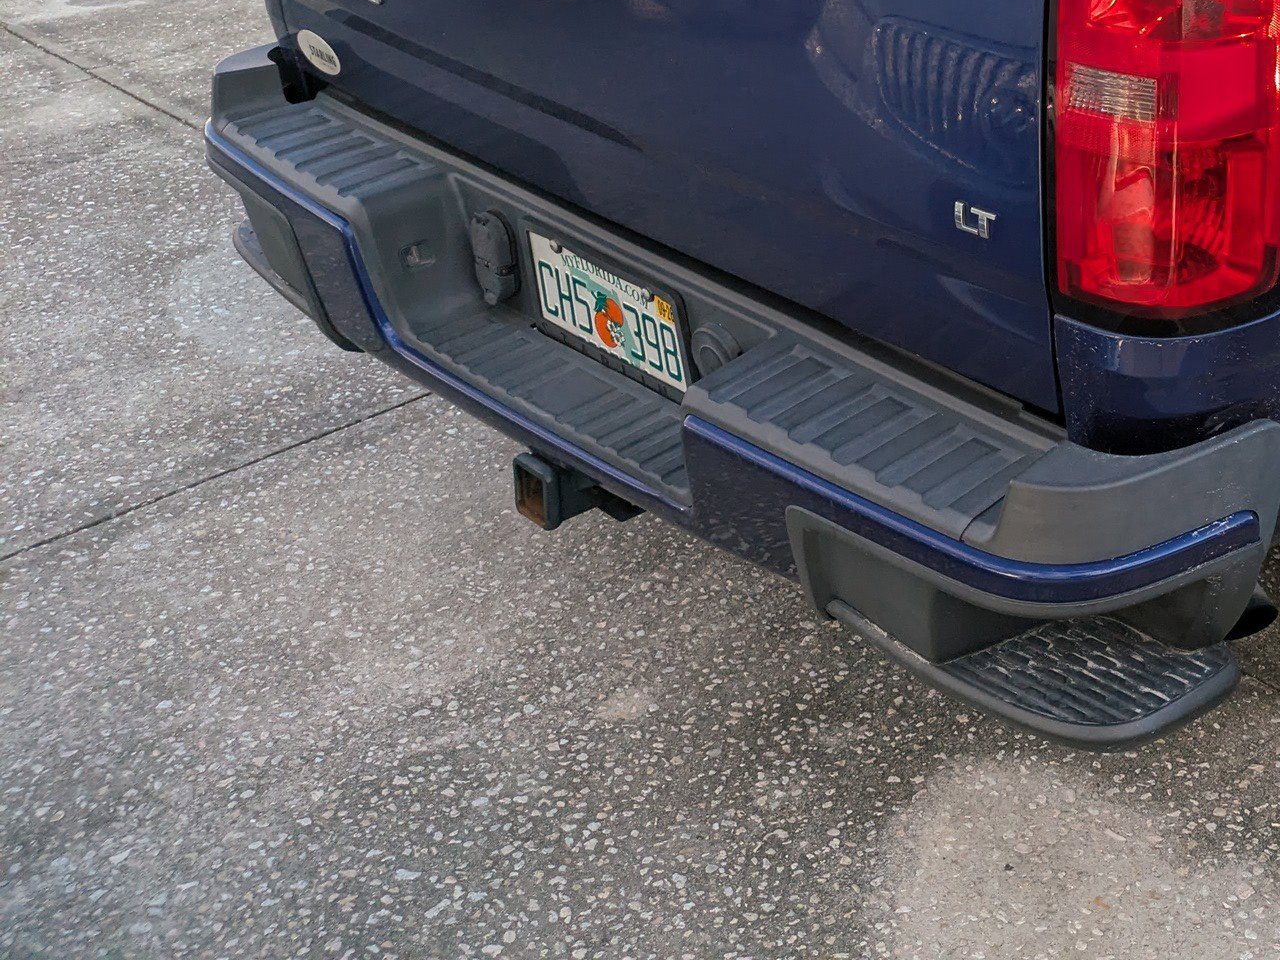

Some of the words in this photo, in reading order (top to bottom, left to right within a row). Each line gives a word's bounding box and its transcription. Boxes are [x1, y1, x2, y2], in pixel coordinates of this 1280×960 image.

[954, 200, 997, 240] LT
[538, 259, 594, 336] CH5
[622, 301, 683, 383] 398
